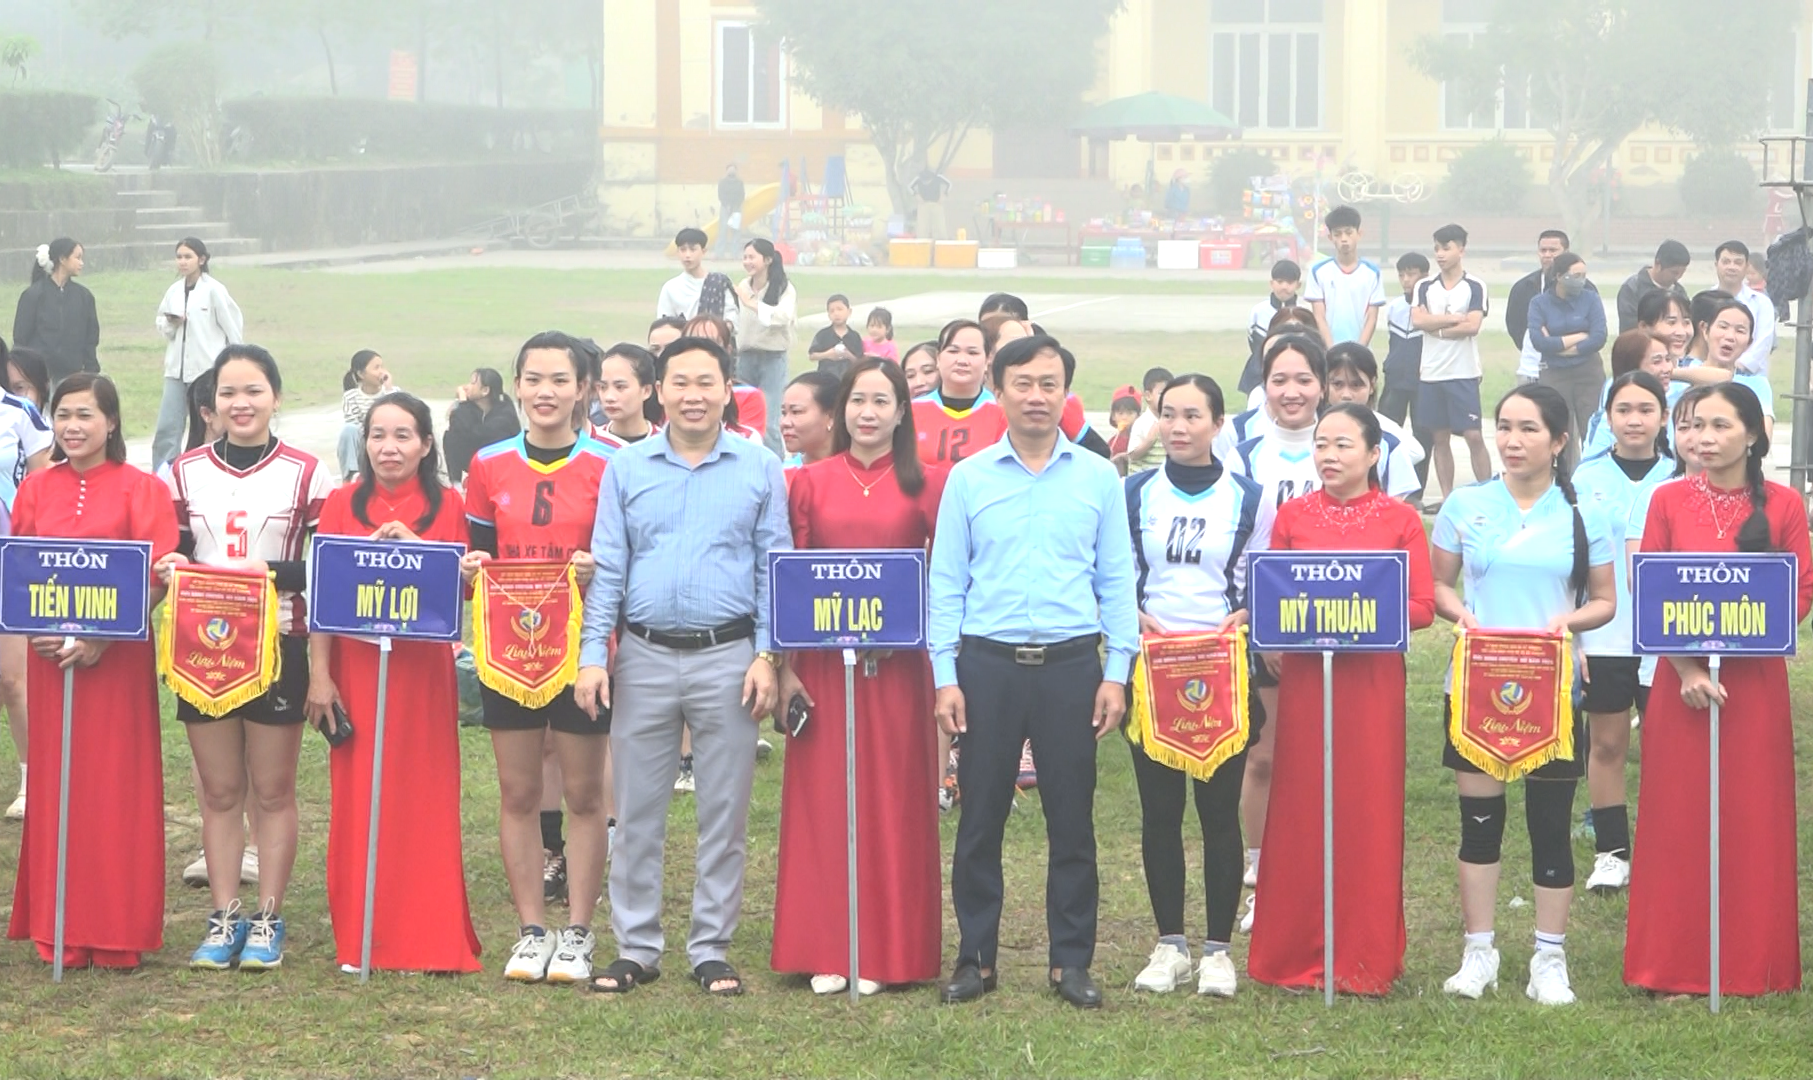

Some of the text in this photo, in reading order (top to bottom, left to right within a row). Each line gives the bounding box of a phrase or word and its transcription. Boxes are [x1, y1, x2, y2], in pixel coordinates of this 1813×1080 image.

[937, 428, 968, 463] 12
[531, 480, 555, 527] 6
[226, 510, 247, 558] 5
[1166, 516, 1206, 565] 02
[39, 547, 108, 569] THÔN
[354, 547, 423, 570] THÔN
[811, 557, 882, 580] THÔN
[1291, 559, 1364, 582] THÔN
[1677, 561, 1750, 583] THÔN
[29, 573, 117, 620] TIẾN VINH
[356, 579, 419, 629] MỸ LỢI
[813, 591, 883, 640] MỸ LẠC
[1279, 592, 1377, 642] MỸ THUẬN
[1663, 594, 1766, 636] PHÚC MÔN
